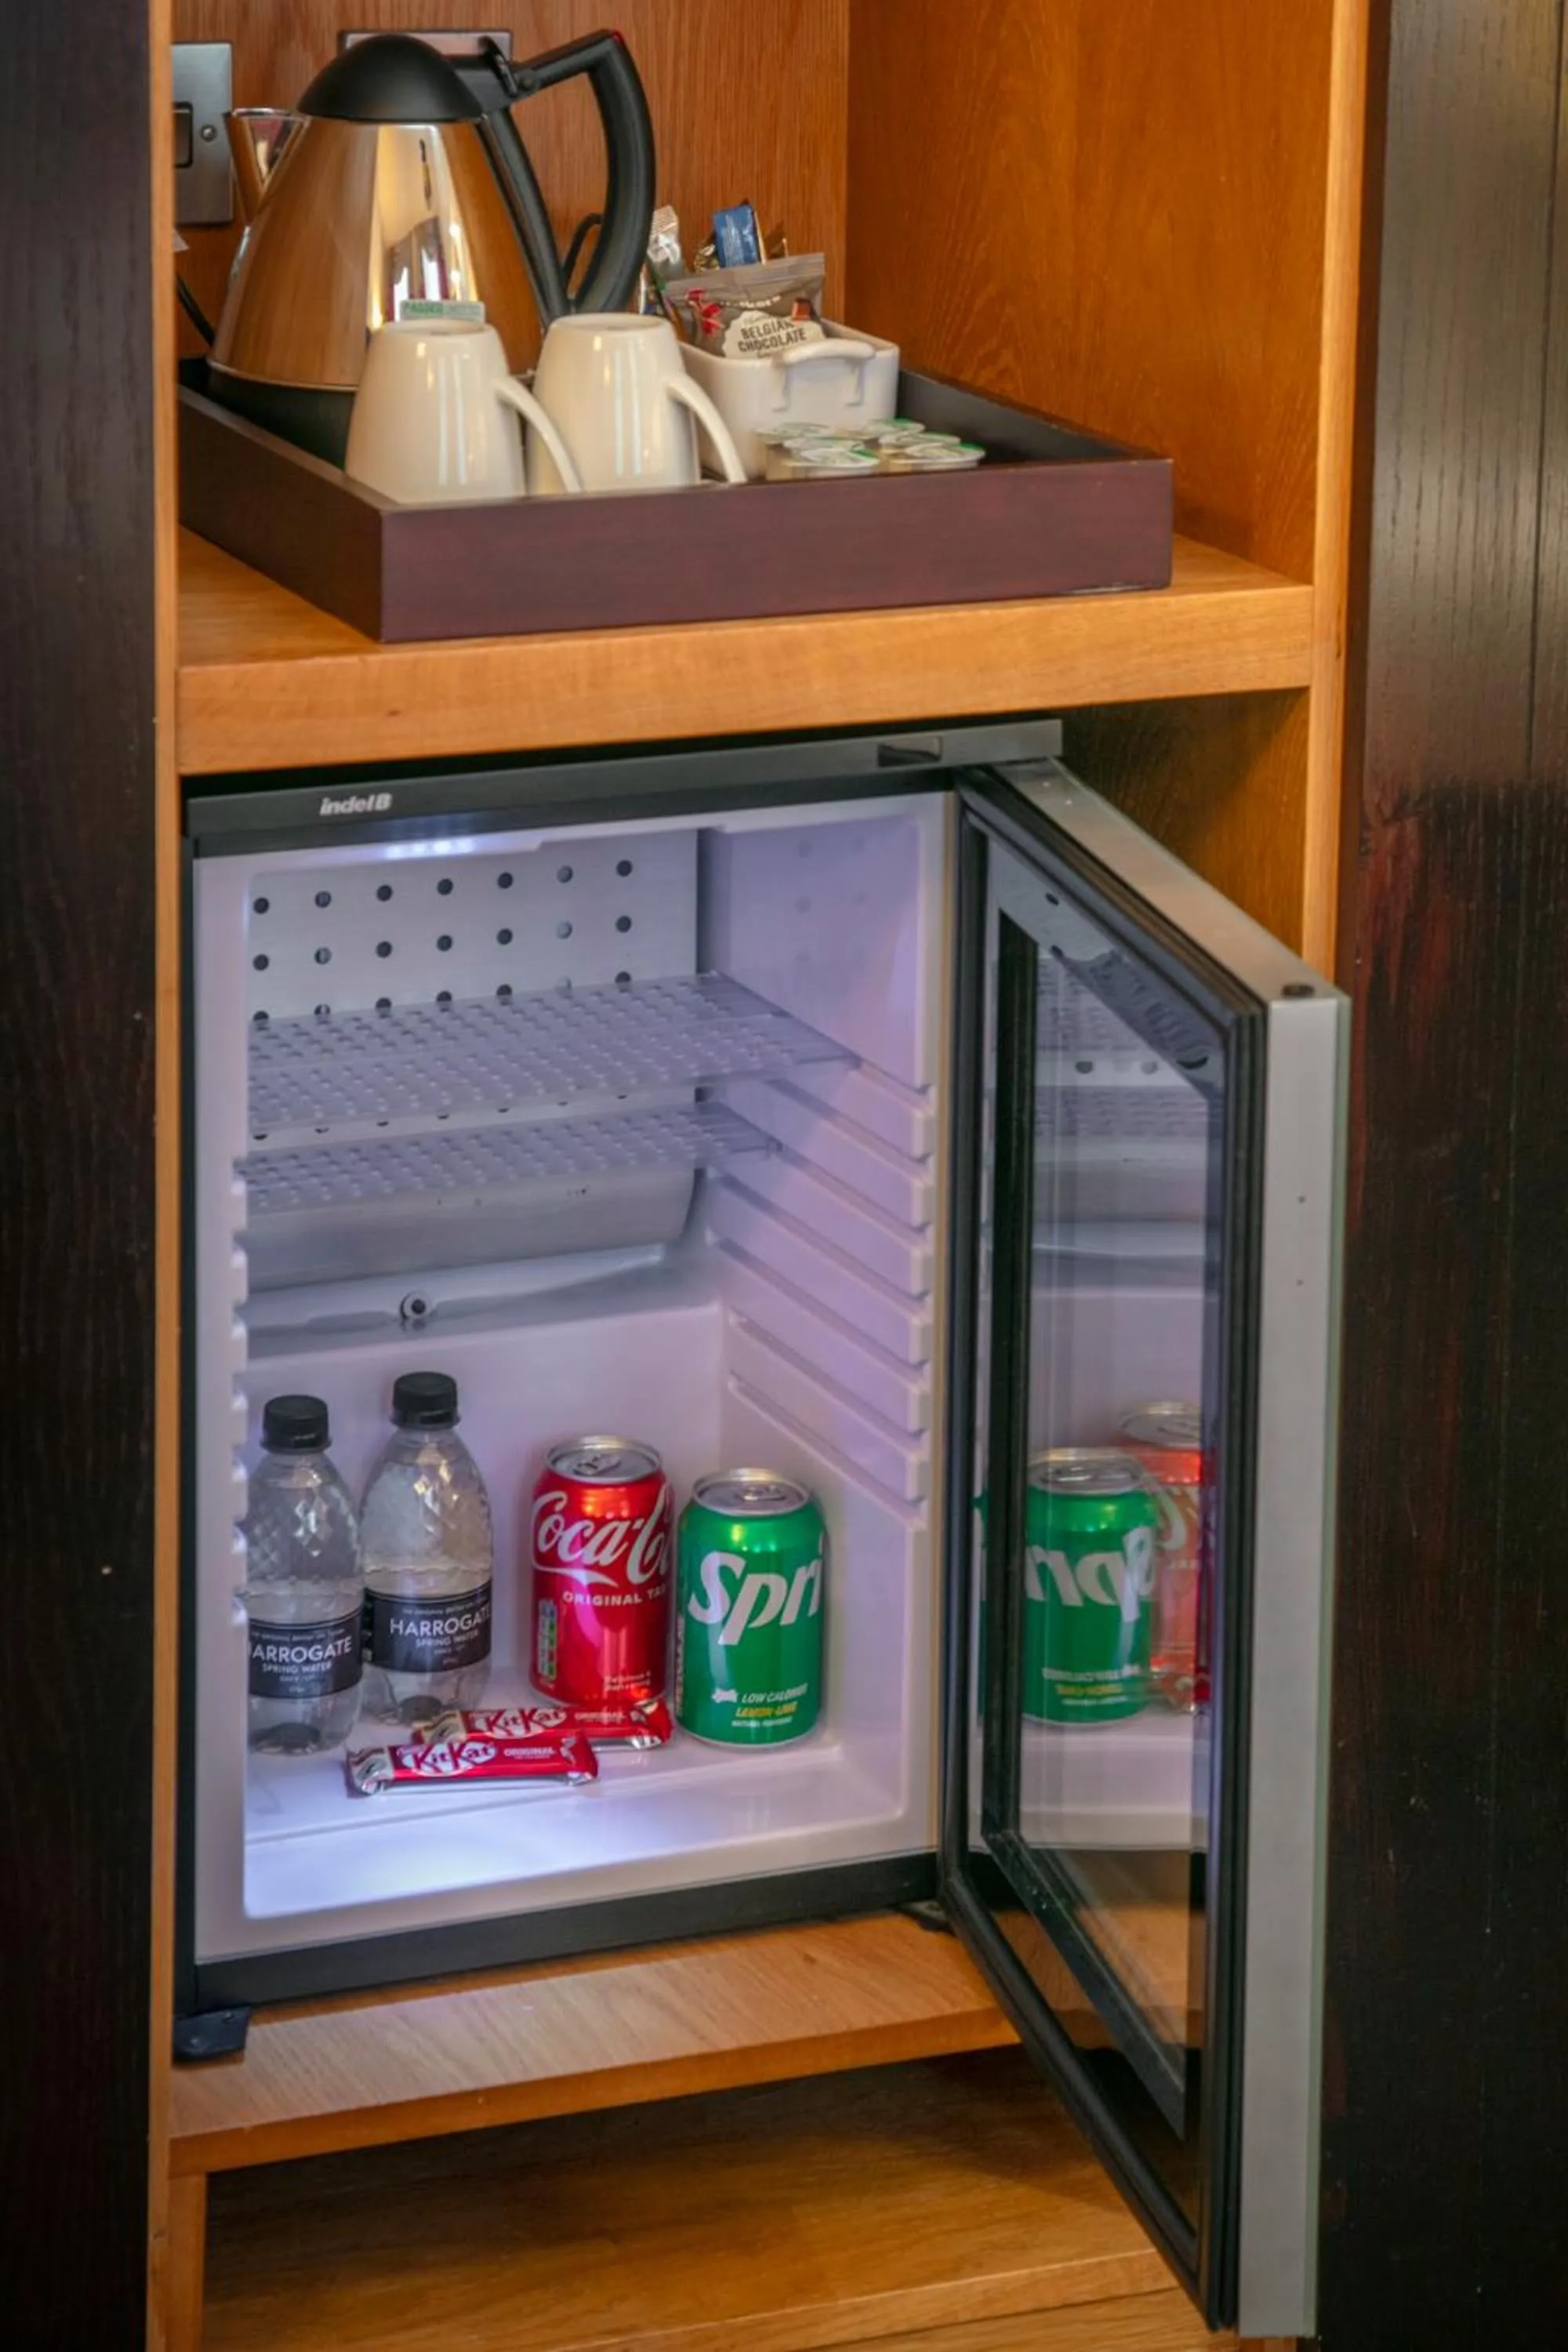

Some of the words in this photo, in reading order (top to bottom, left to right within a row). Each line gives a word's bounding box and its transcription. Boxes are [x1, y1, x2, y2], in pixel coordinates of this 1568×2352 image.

[741, 319, 794, 339] BELGIAN
[738, 328, 807, 353] CHOCOLATE
[563, 1589, 643, 1606] ORIGINAL
[250, 1635, 352, 1663] ARROGATE
[742, 1692, 766, 1704] LOW
